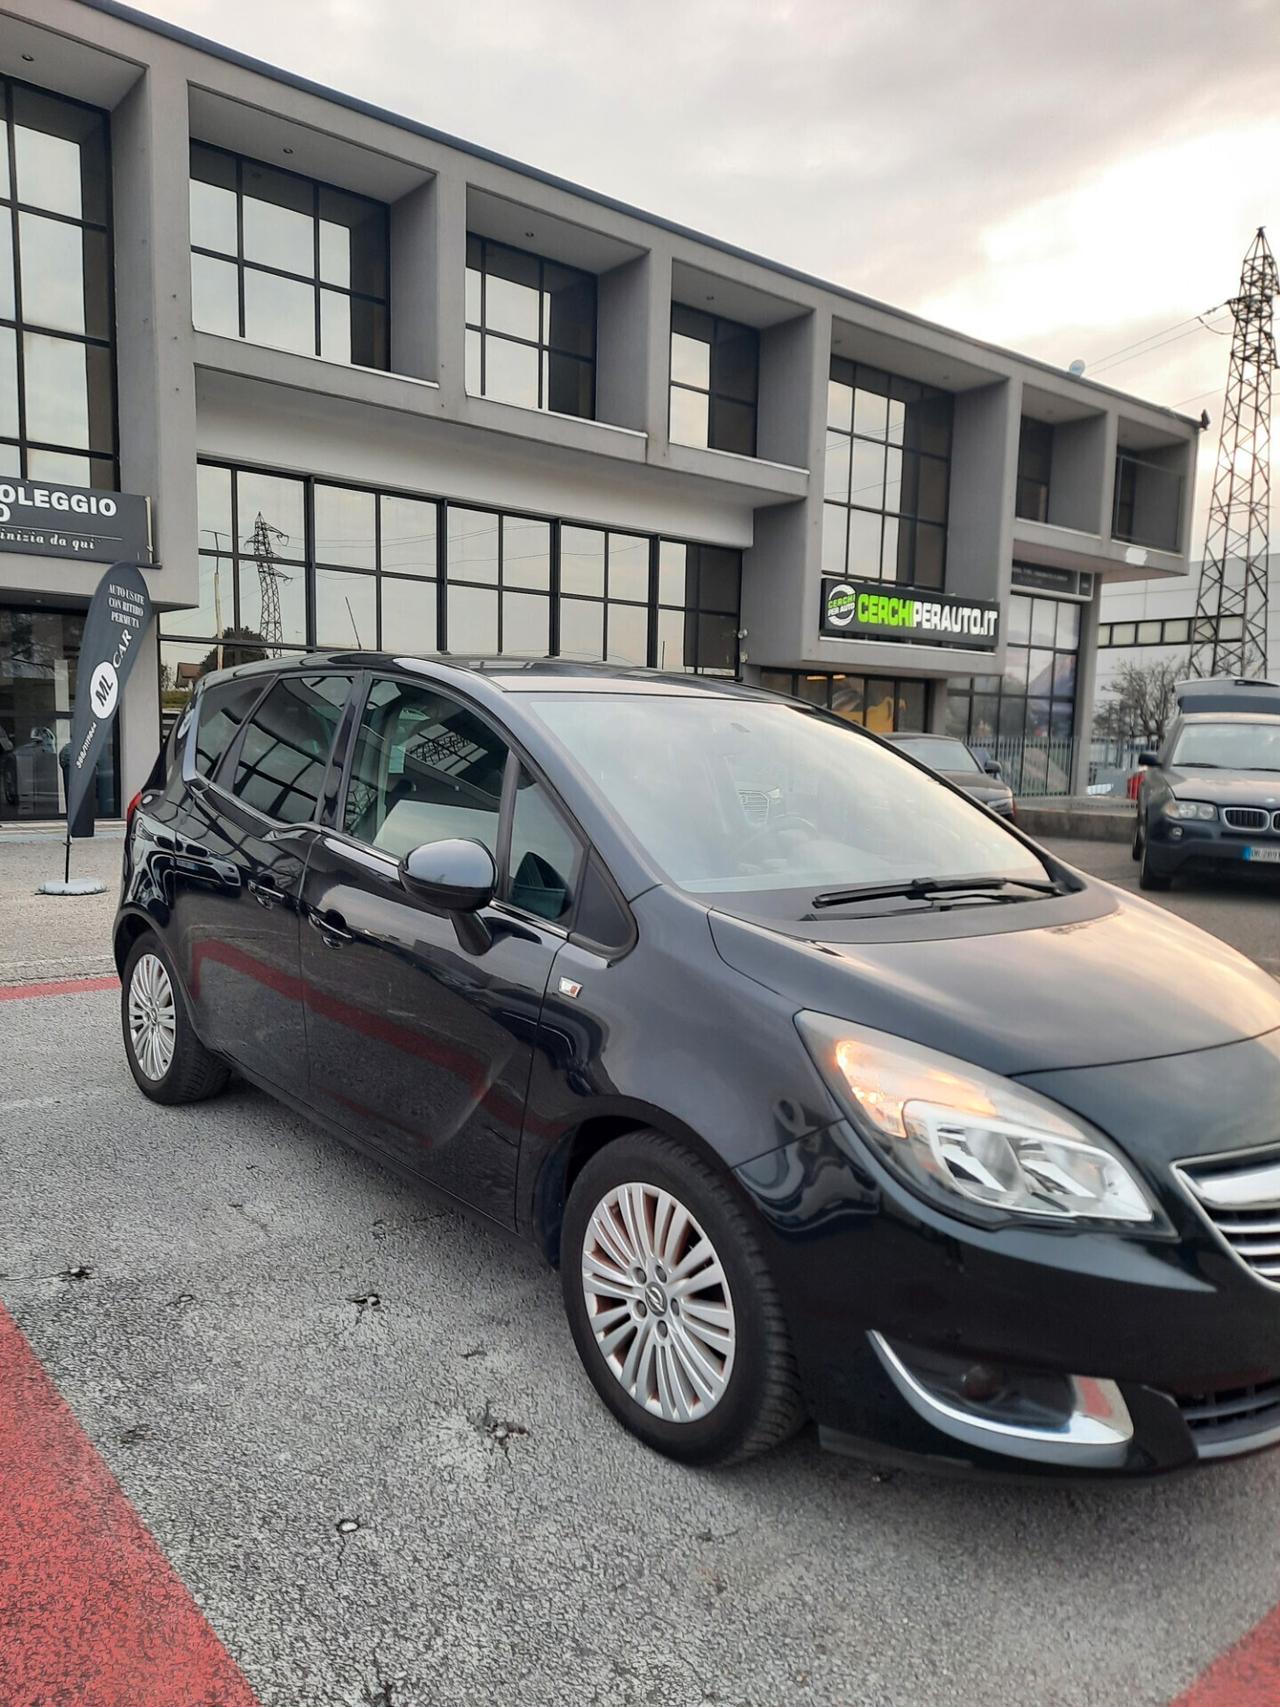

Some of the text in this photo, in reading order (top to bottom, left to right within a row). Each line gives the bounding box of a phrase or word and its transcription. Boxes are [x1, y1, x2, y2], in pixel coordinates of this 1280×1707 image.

[0, 484, 117, 517] OLEGGIO
[0, 528, 95, 551] inizia da qui
[109, 583, 145, 606] AUTO USATE
[828, 594, 856, 609] CERCHI
[108, 597, 144, 617] CON RITIRO
[828, 607, 840, 617] PER
[857, 593, 998, 637] CERCHIPERAUTO.IT
[111, 611, 140, 628] PERMUTA
[95, 629, 132, 707] ML CAR
